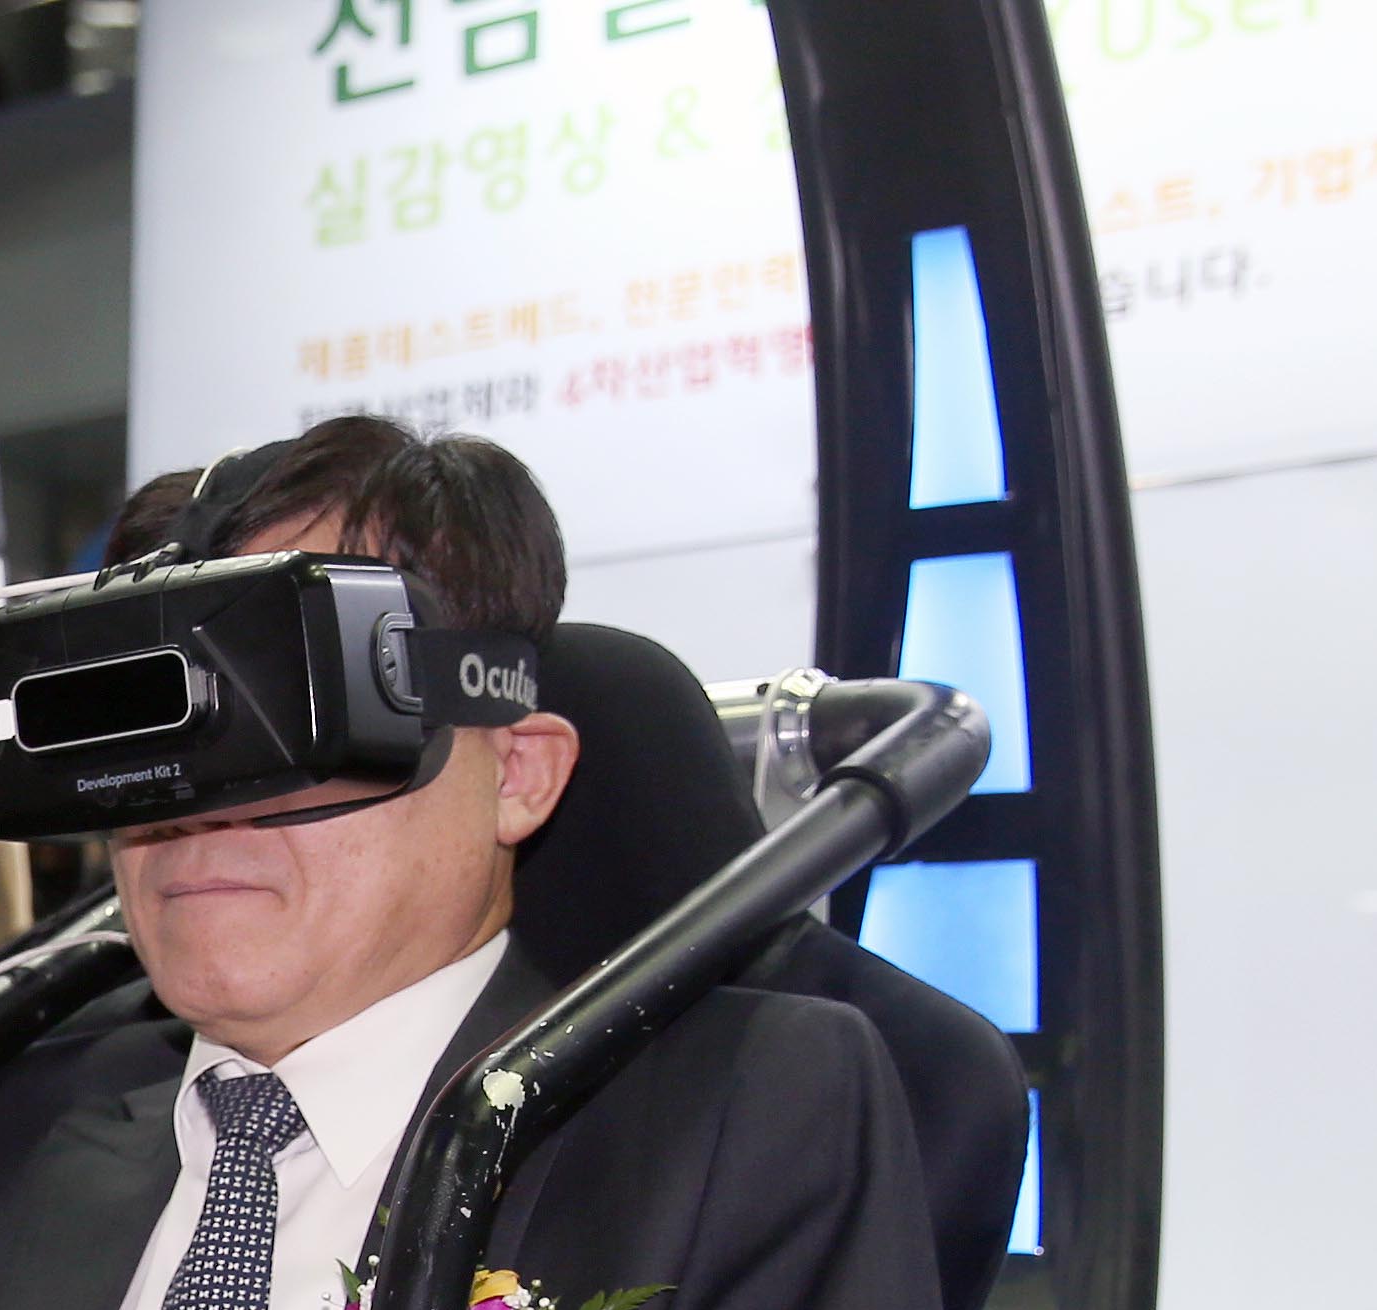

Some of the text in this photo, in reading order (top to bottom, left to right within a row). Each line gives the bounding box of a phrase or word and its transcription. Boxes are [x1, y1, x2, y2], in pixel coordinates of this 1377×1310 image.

[77, 763, 182, 793] Development Kit 2
